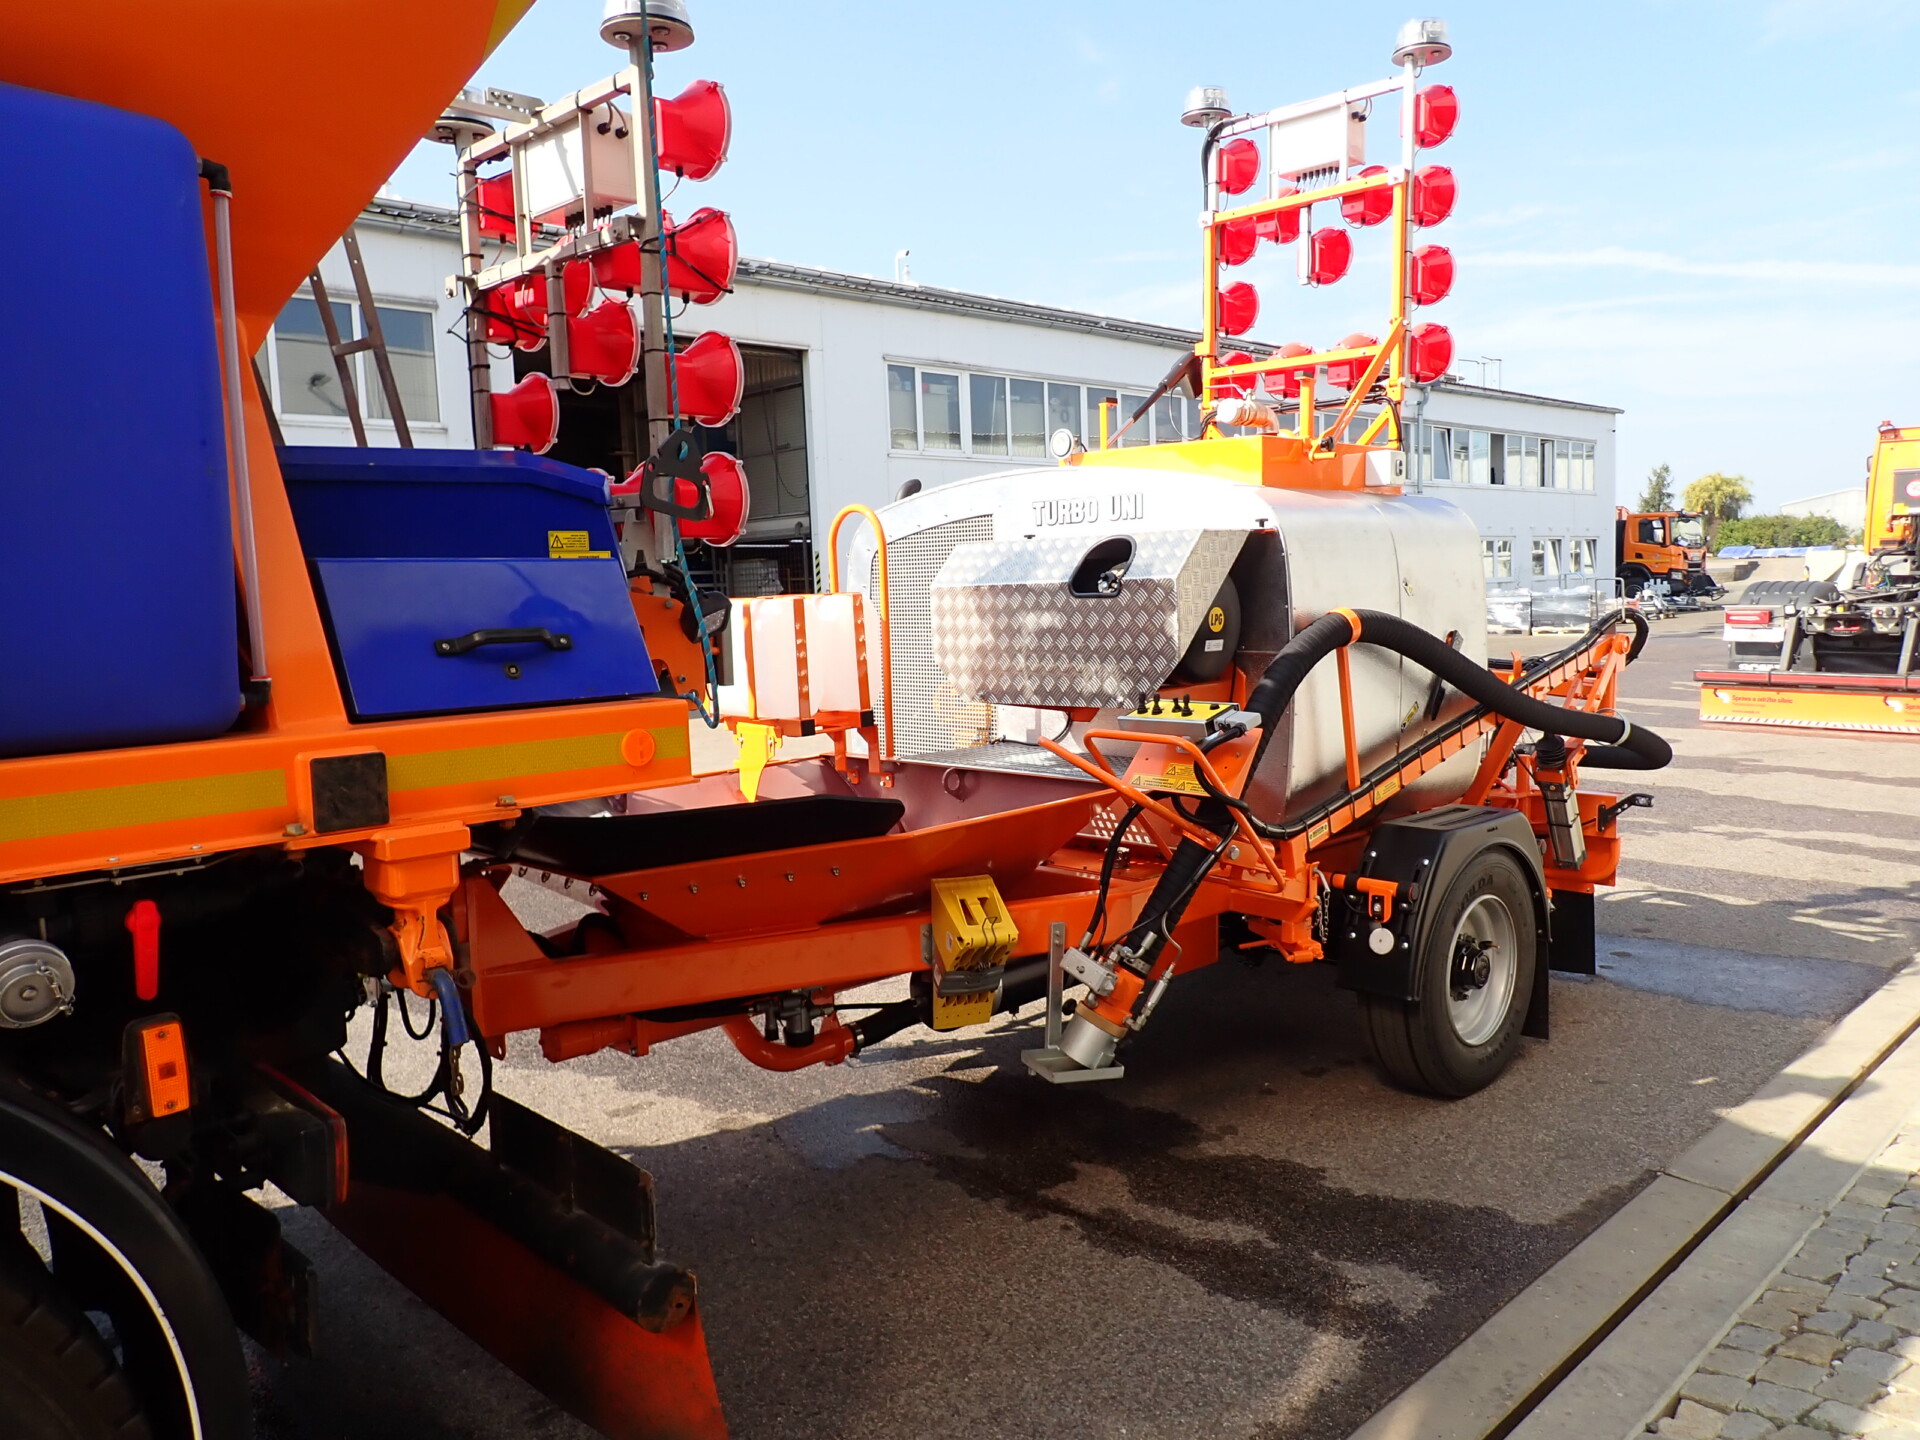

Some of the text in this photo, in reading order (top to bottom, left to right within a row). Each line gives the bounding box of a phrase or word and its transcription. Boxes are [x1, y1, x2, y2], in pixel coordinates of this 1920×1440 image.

[1032, 492, 1144, 526] TURBO UNI
[1210, 613, 1223, 626] LPG
